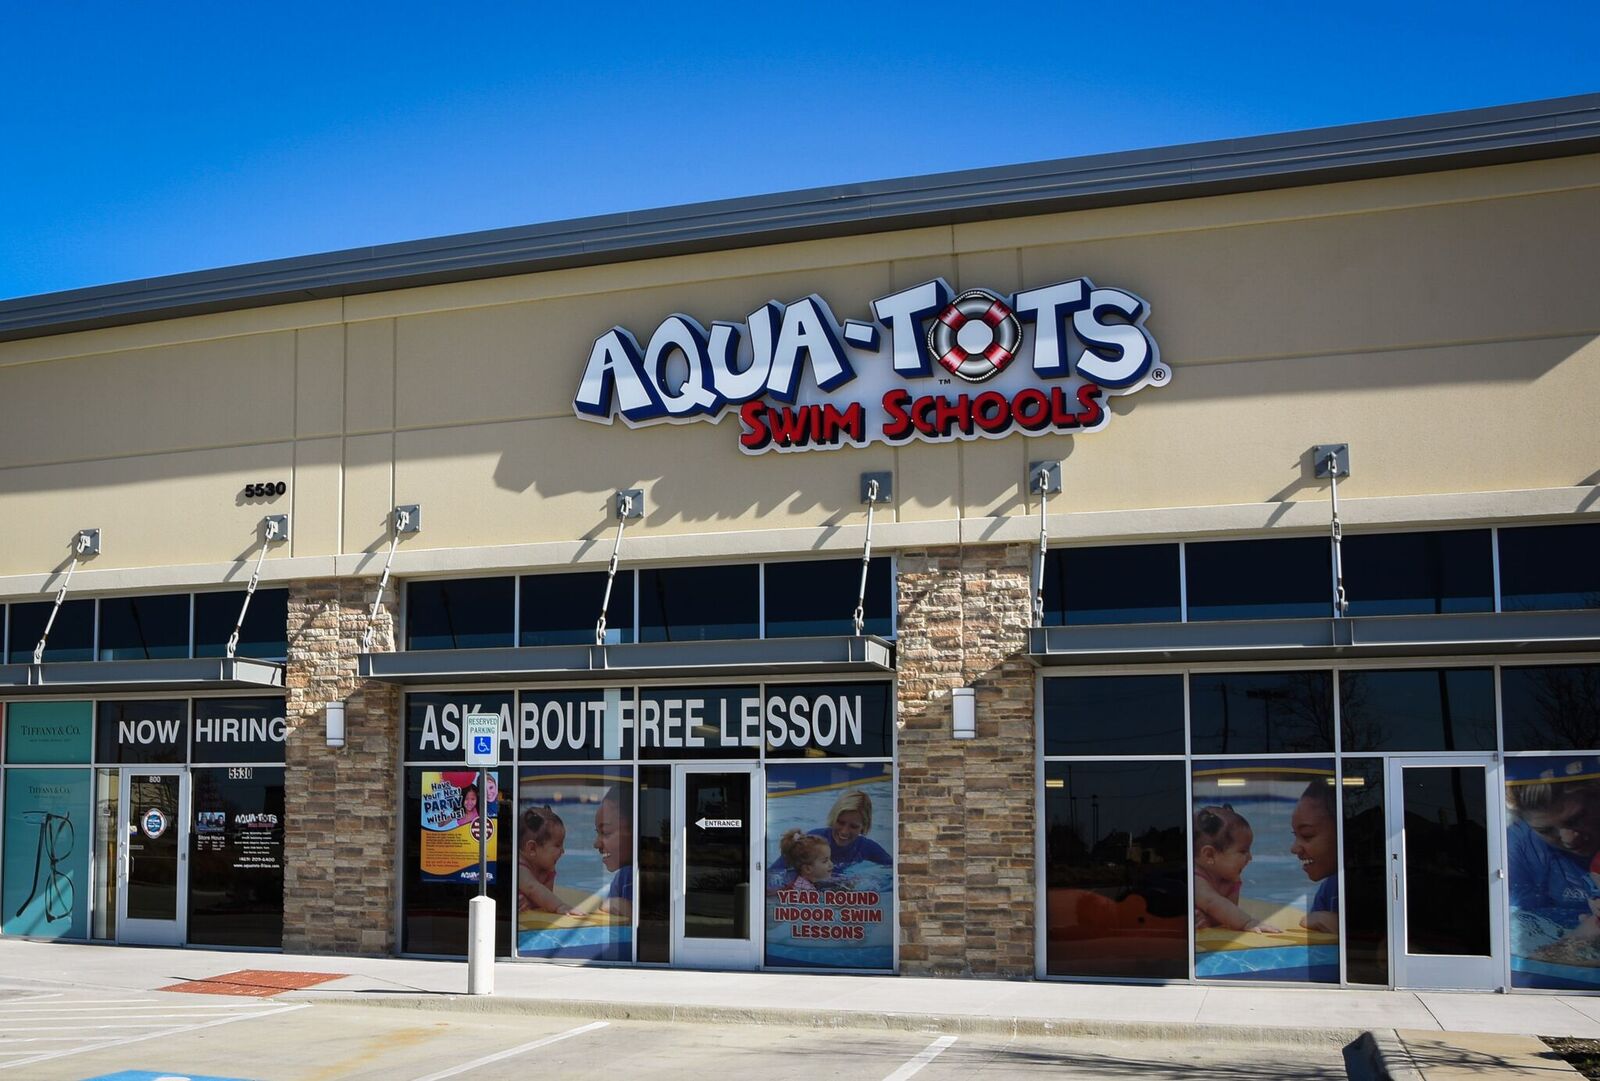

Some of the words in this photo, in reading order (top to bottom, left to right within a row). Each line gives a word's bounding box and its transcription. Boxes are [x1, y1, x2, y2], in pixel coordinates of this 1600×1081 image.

[574, 278, 1152, 421] AQUA-TOTS
[882, 383, 1102, 439] SCHOOLS
[245, 481, 287, 498] 5530
[468, 717, 498, 726] RESERVED
[498, 700, 608, 750] ABOUT
[617, 698, 705, 748] FREE
[720, 694, 863, 748] LESSON
[118, 719, 181, 745] NOW
[195, 716, 287, 743] HIRING
[469, 726, 496, 734] PARKING
[149, 775, 161, 783] 800
[424, 796, 463, 813] PARTY
[426, 811, 447, 823] with
[778, 890, 819, 905] YEAR
[825, 891, 879, 906] ROUND
[775, 907, 834, 922] INDOOR
[841, 908, 883, 923] SWIM
[792, 924, 865, 940] LESSONS
